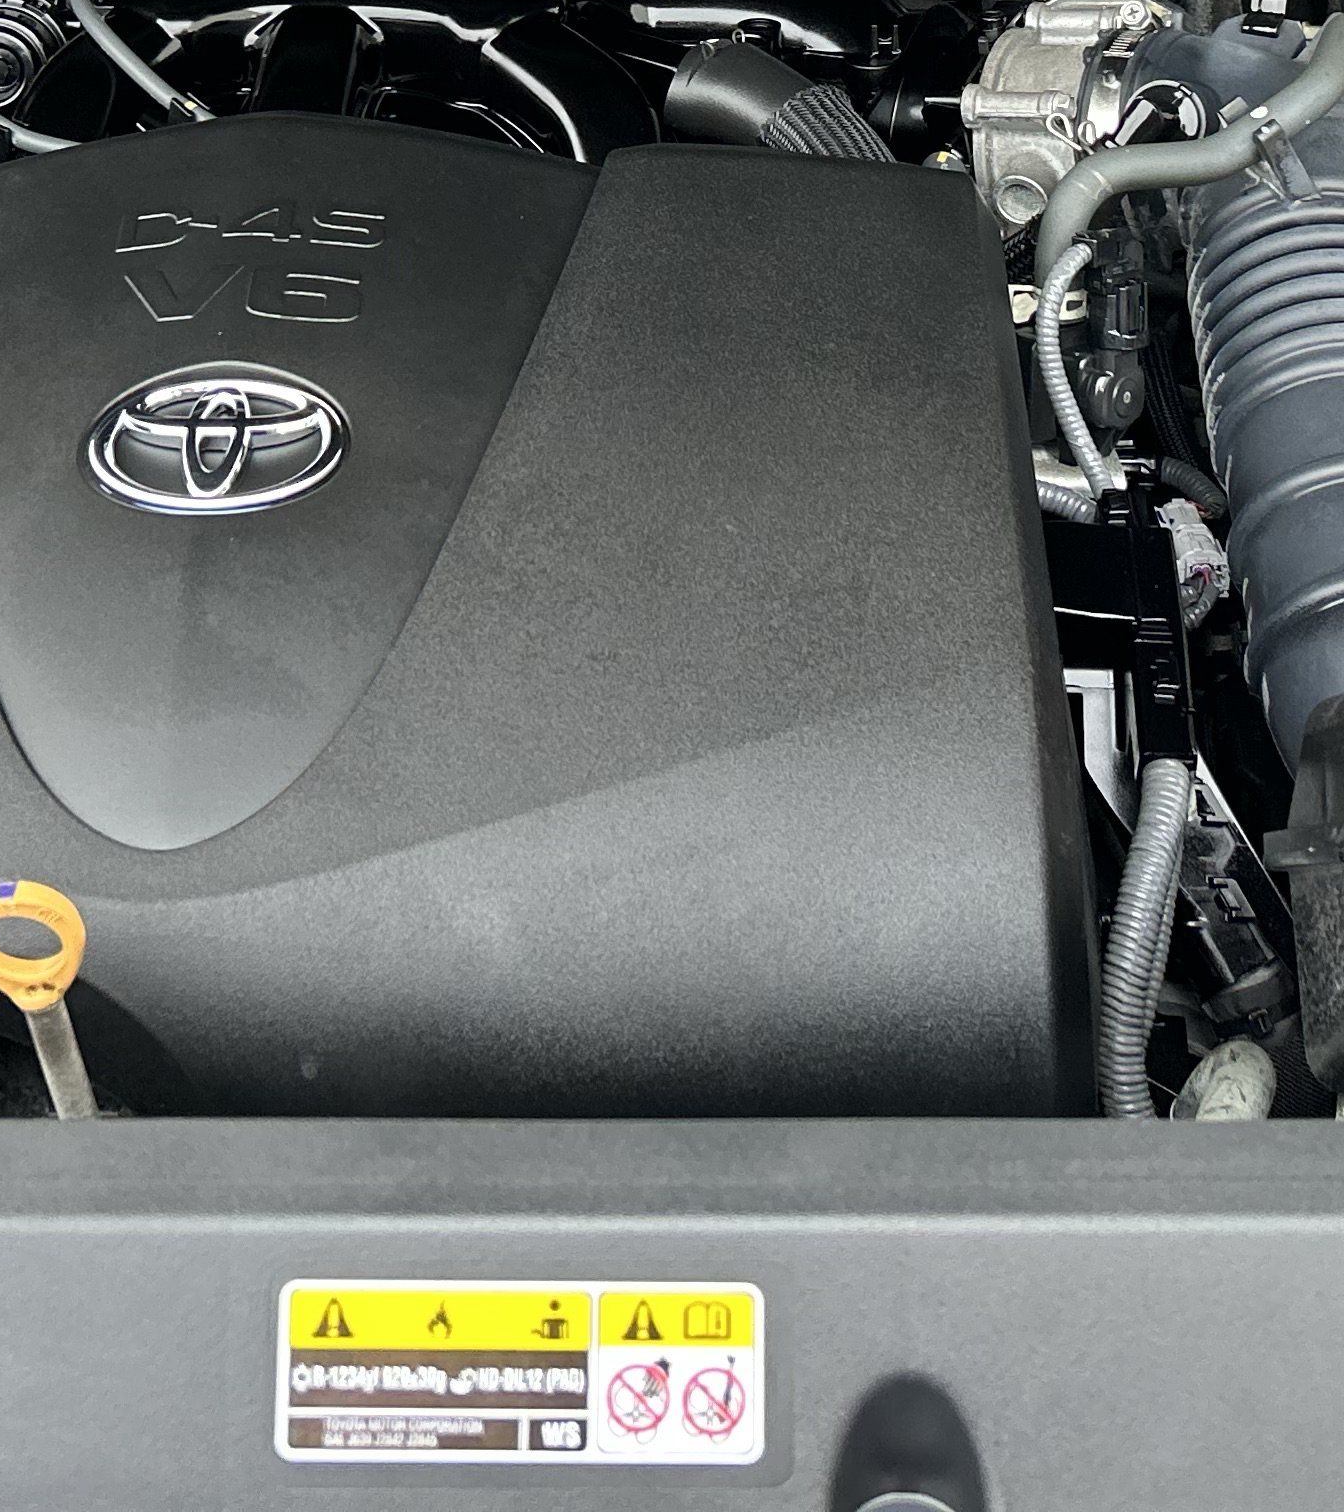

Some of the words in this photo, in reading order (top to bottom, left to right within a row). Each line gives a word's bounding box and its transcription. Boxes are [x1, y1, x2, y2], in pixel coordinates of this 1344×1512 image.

[115, 207, 386, 253] D-4S
[122, 264, 363, 322] V6
[541, 1420, 582, 1449] WS
